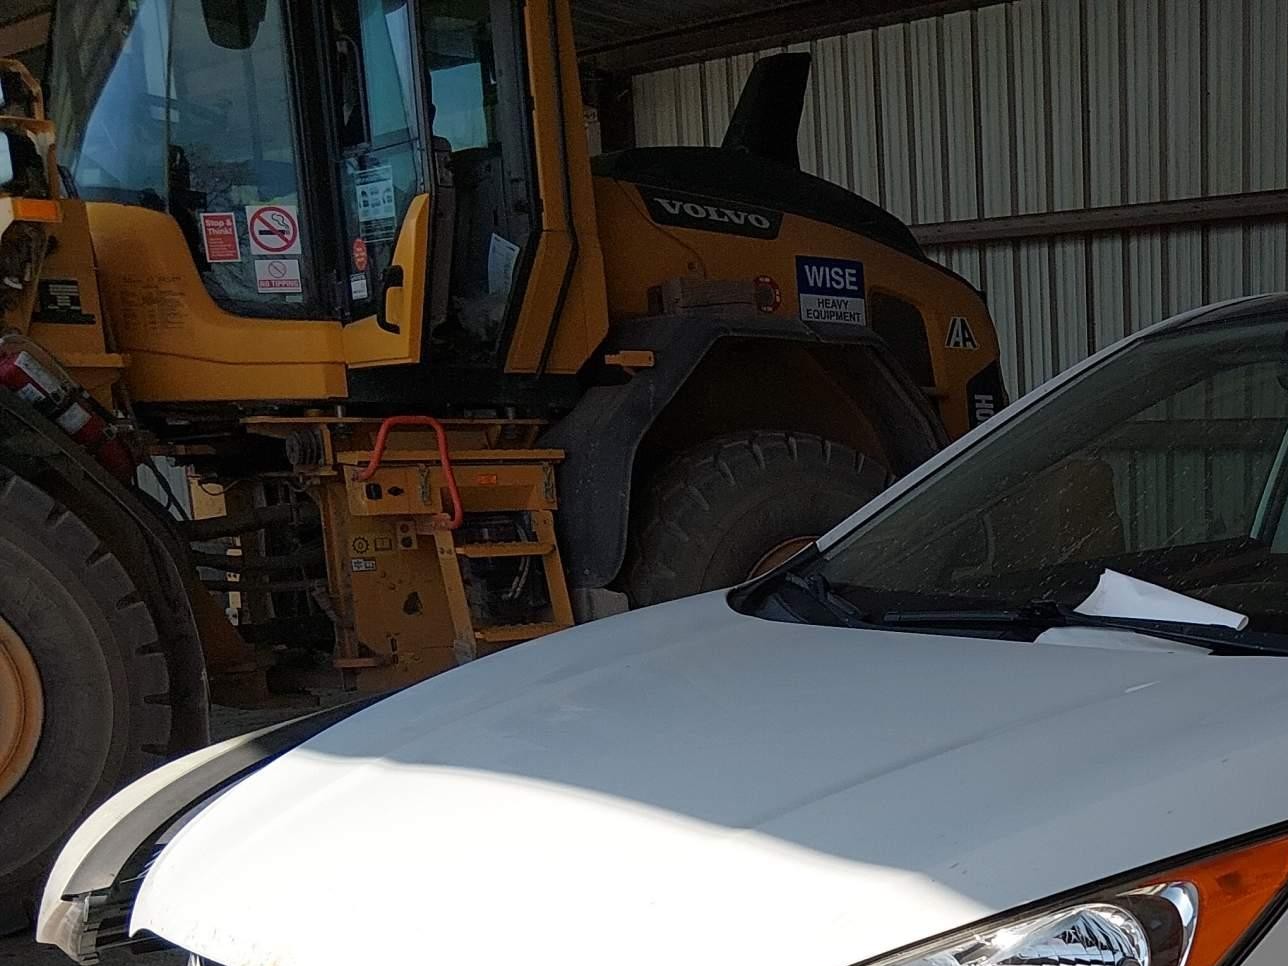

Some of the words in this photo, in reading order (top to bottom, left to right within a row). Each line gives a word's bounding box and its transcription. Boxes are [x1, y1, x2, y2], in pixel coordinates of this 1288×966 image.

[653, 197, 770, 229] VOLVO
[205, 219, 225, 228] Stop
[207, 227, 233, 235] Think!
[803, 264, 859, 291] WISE
[817, 298, 849, 310] HEAVY
[806, 309, 863, 323] EQUIPMENT
